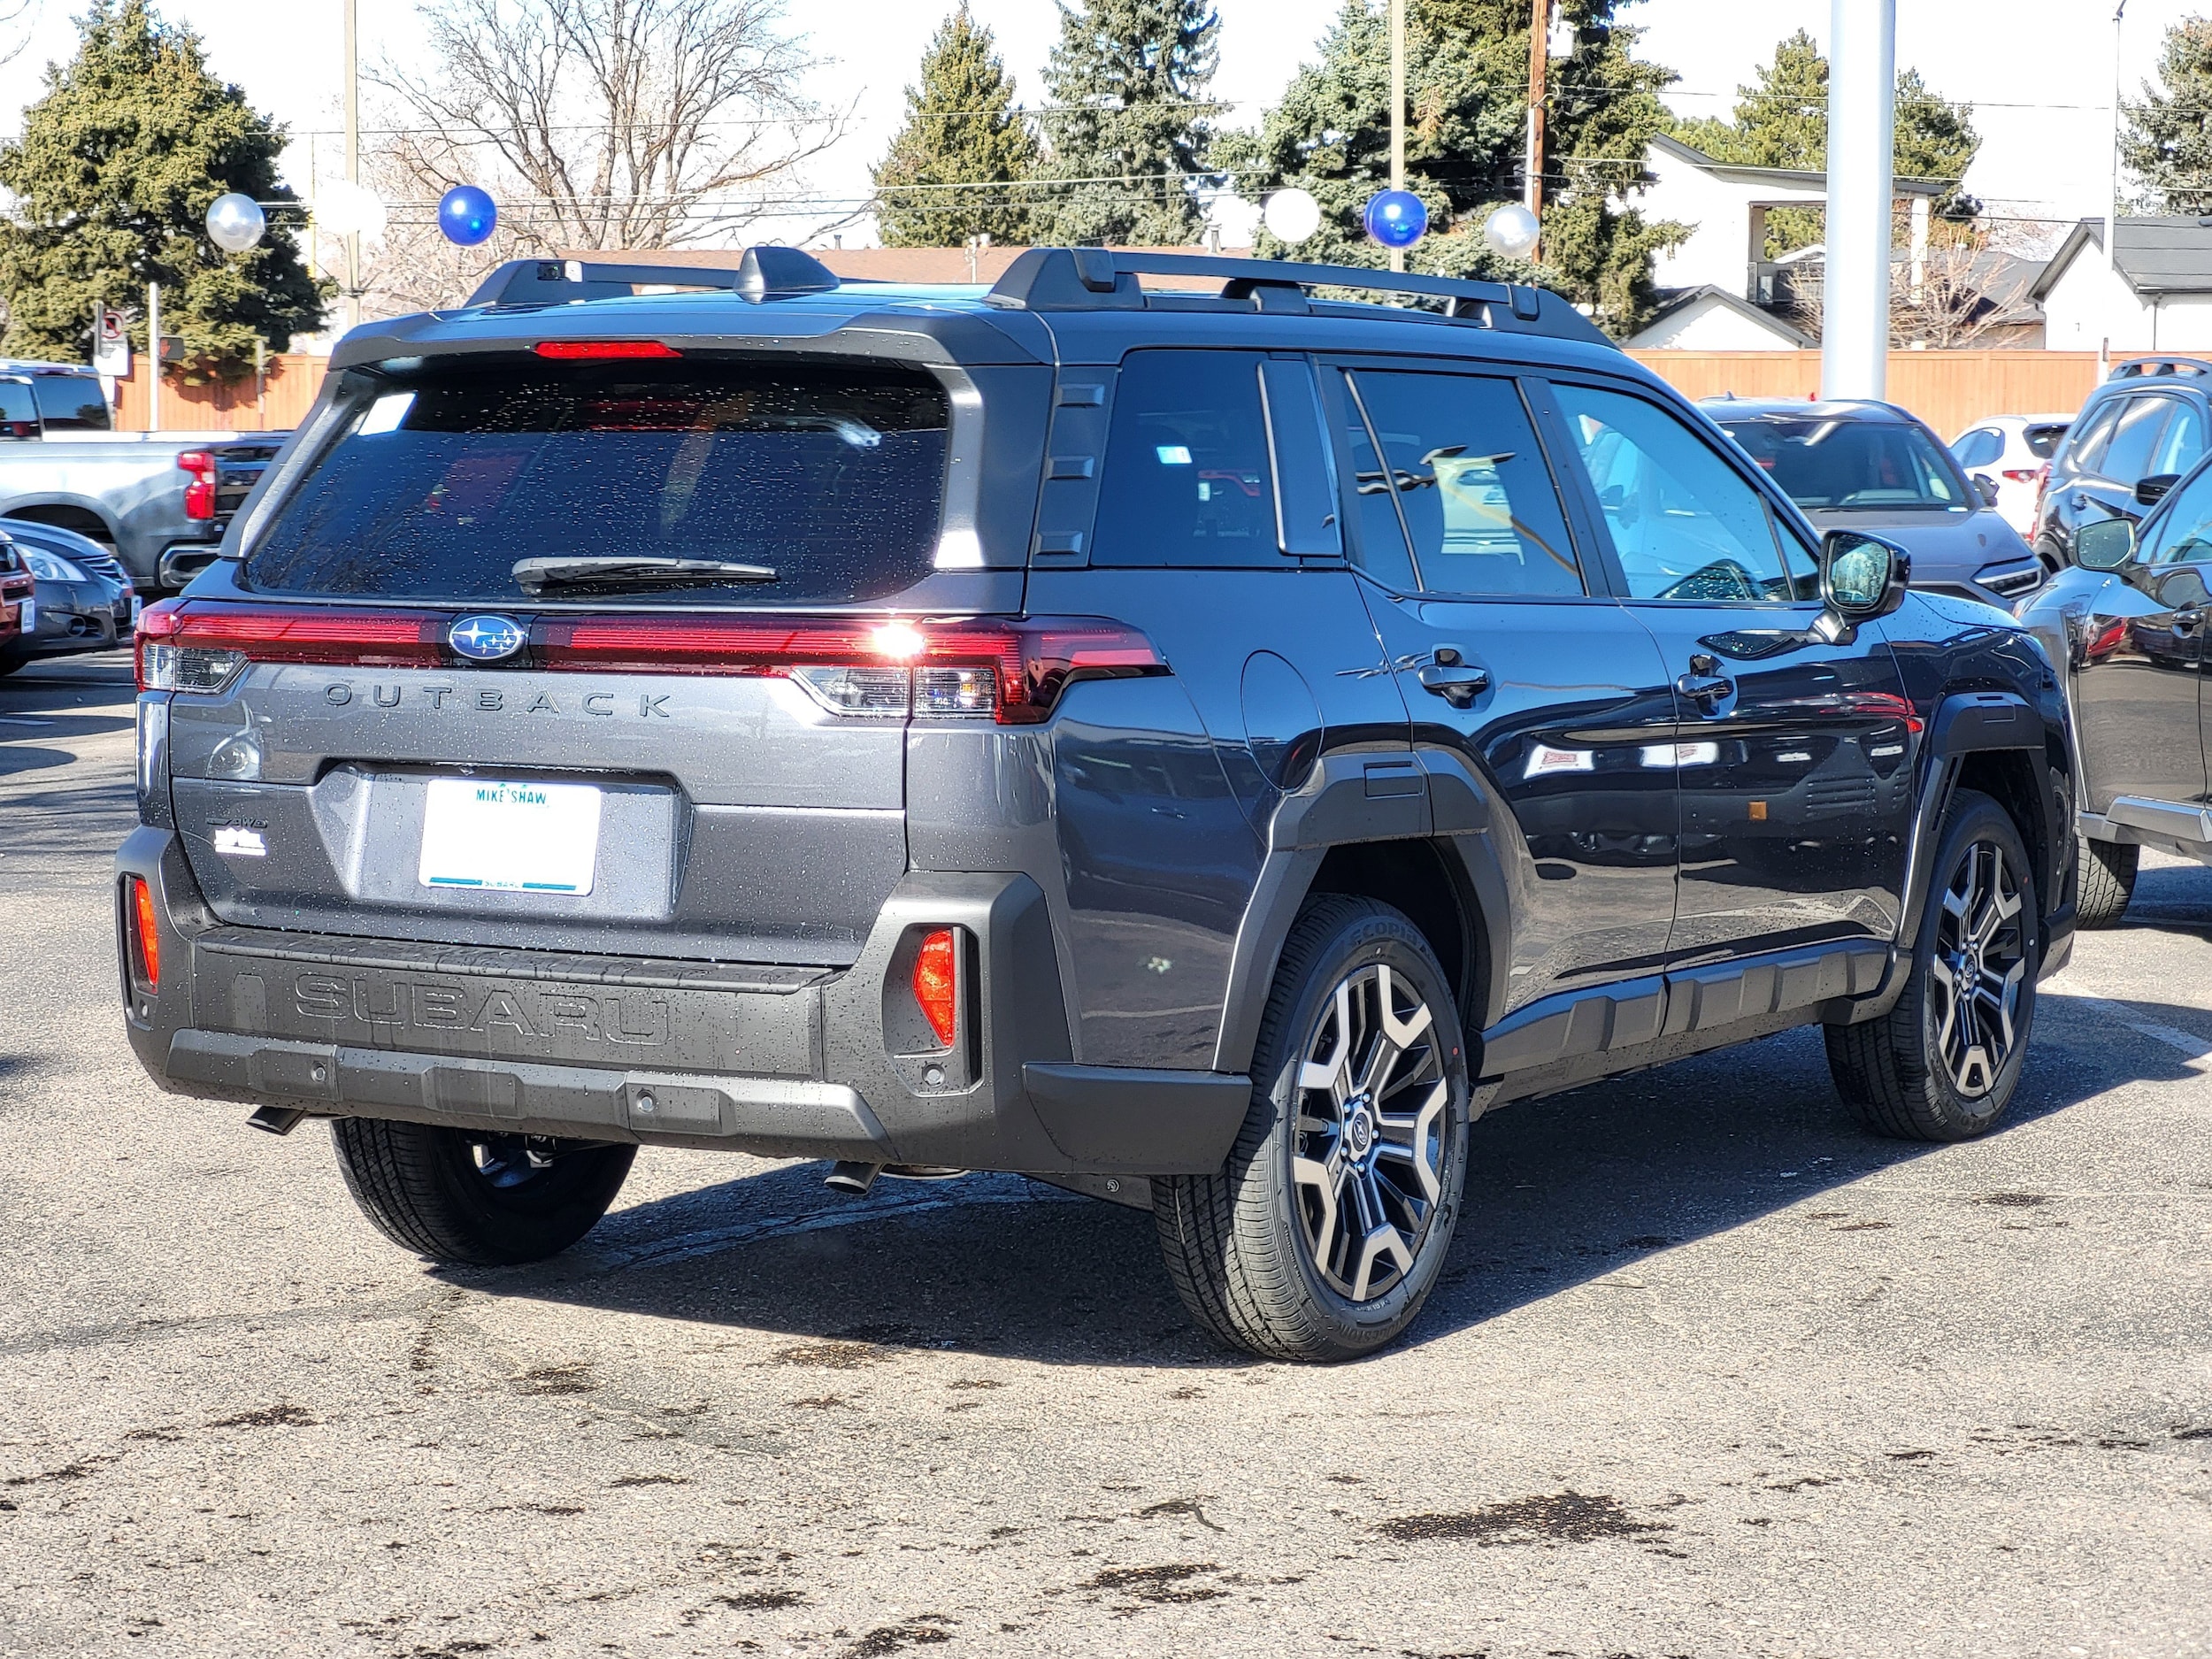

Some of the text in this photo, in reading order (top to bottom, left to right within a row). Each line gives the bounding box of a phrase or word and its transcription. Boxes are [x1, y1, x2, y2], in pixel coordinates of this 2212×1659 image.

[324, 684, 672, 718] OUTBACK
[476, 789, 547, 804] MIKE SHAW
[296, 973, 669, 1046] SUBARU
